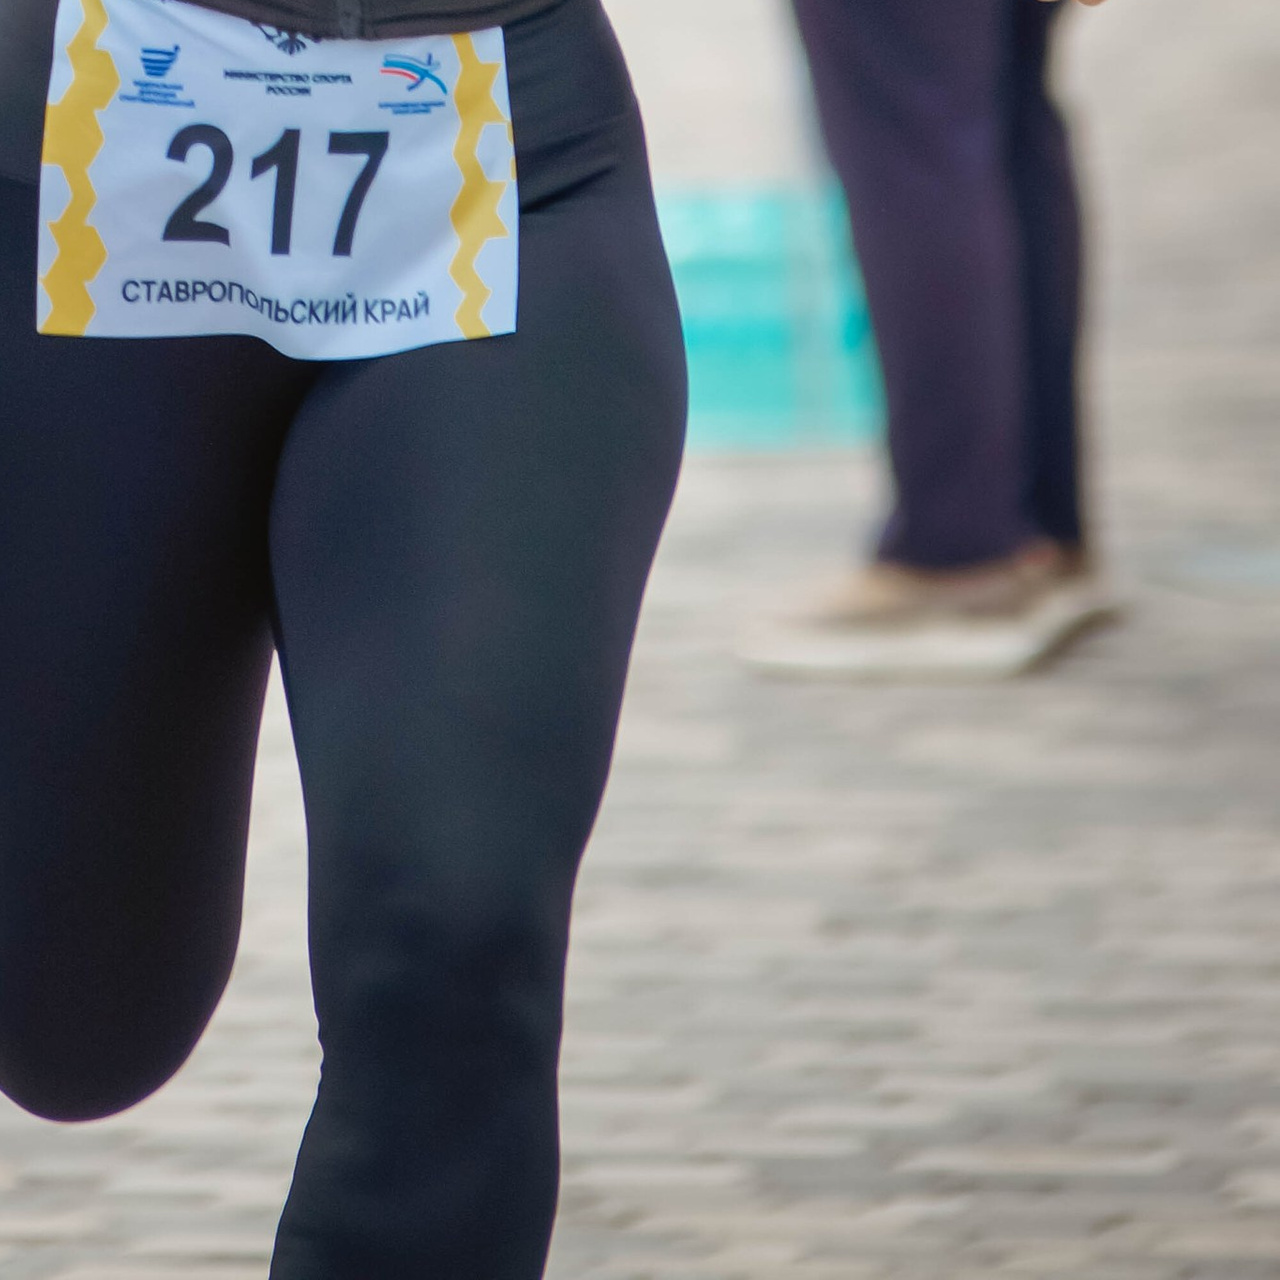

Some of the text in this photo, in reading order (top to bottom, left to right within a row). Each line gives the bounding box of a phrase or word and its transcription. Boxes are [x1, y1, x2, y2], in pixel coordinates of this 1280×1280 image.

[162, 124, 389, 257] 217
[122, 280, 430, 325] СТАВРОПОЛЬСКИЙ КРАЙ
